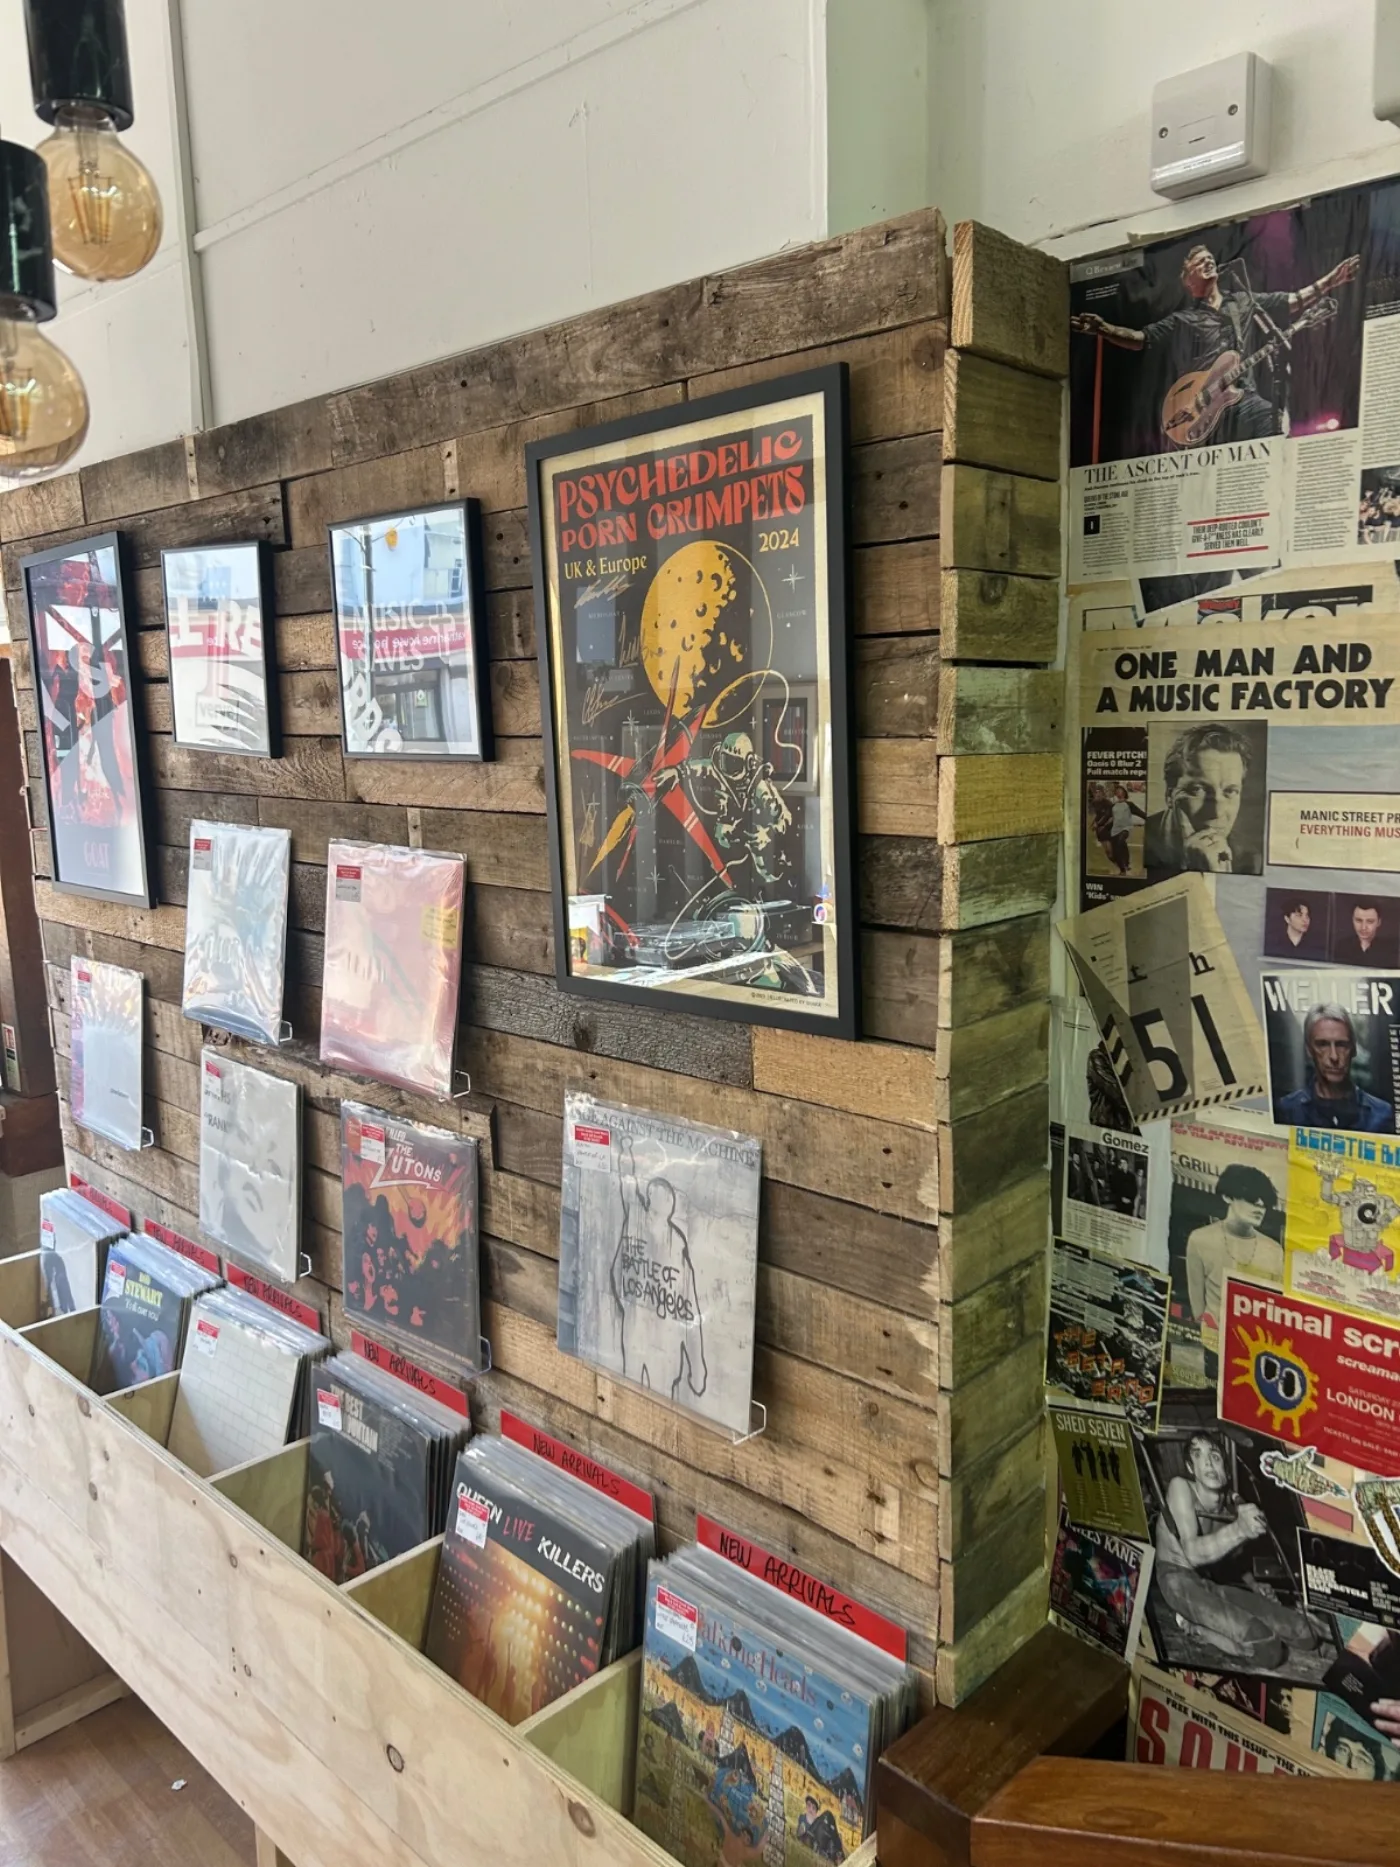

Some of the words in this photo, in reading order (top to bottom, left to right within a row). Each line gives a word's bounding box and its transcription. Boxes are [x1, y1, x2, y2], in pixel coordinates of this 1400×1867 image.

[558, 430, 802, 523] PSYCHEDELIC
[1084, 464, 1118, 484] THE
[1124, 453, 1194, 479] ASCENT
[1197, 448, 1222, 466] OF
[1228, 441, 1272, 462] MAN
[561, 512, 637, 552] PORN
[646, 465, 806, 540] CRUMPETS
[759, 527, 800, 552] 2024
[564, 562, 584, 580] UK
[586, 559, 597, 576] &
[599, 555, 648, 579] Europe
[1115, 651, 1178, 680] ONE
[1194, 647, 1274, 677] MAN
[1292, 642, 1372, 675] AND
[1096, 687, 1119, 713] A
[1128, 683, 1220, 712] MUSIC
[1231, 678, 1394, 711] FACTORY
[1087, 751, 1115, 759] FEVER
[1087, 768, 1102, 776] Full
[1102, 768, 1129, 776] match
[1117, 760, 1134, 768] Blur
[1300, 809, 1340, 822] MANIC
[1342, 811, 1383, 823] STREET
[1300, 823, 1371, 837] EVERYTHING
[1264, 980, 1394, 1016] WELLER
[395, 1142, 413, 1156] THE
[600, 1112, 653, 1138] AGAINST
[658, 1125, 685, 1148] THE
[686, 1134, 758, 1168] MACHINE
[1102, 1132, 1149, 1154] Gomez
[1296, 1127, 1376, 1161] BEASTIE
[621, 1235, 647, 1257] THE
[622, 1252, 662, 1282] BATTLE
[662, 1265, 680, 1289] OF
[622, 1275, 643, 1298] LOS
[125, 1279, 163, 1308] STEWART
[1233, 1293, 1333, 1340] primal
[1343, 1326, 1400, 1359] scr
[363, 1338, 379, 1363] NEW
[389, 1353, 436, 1395] ARRIVALS
[1336, 1354, 1400, 1383] screama
[1326, 1387, 1395, 1422] LONDON
[1055, 1412, 1086, 1434] SHED
[1088, 1418, 1126, 1441] SEVEN
[533, 1433, 555, 1460] NEW
[561, 1450, 620, 1496] ARRIVALS
[502, 1515, 536, 1543] LIVE
[537, 1535, 605, 1594] KILLERS
[1104, 1534, 1139, 1570] KANE
[720, 1531, 751, 1568] NEW
[764, 1556, 856, 1626] ARRIVALS
[1166, 1697, 1189, 1716] FREE
[1192, 1709, 1217, 1731] WITH
[1218, 1724, 1240, 1743] THIS
